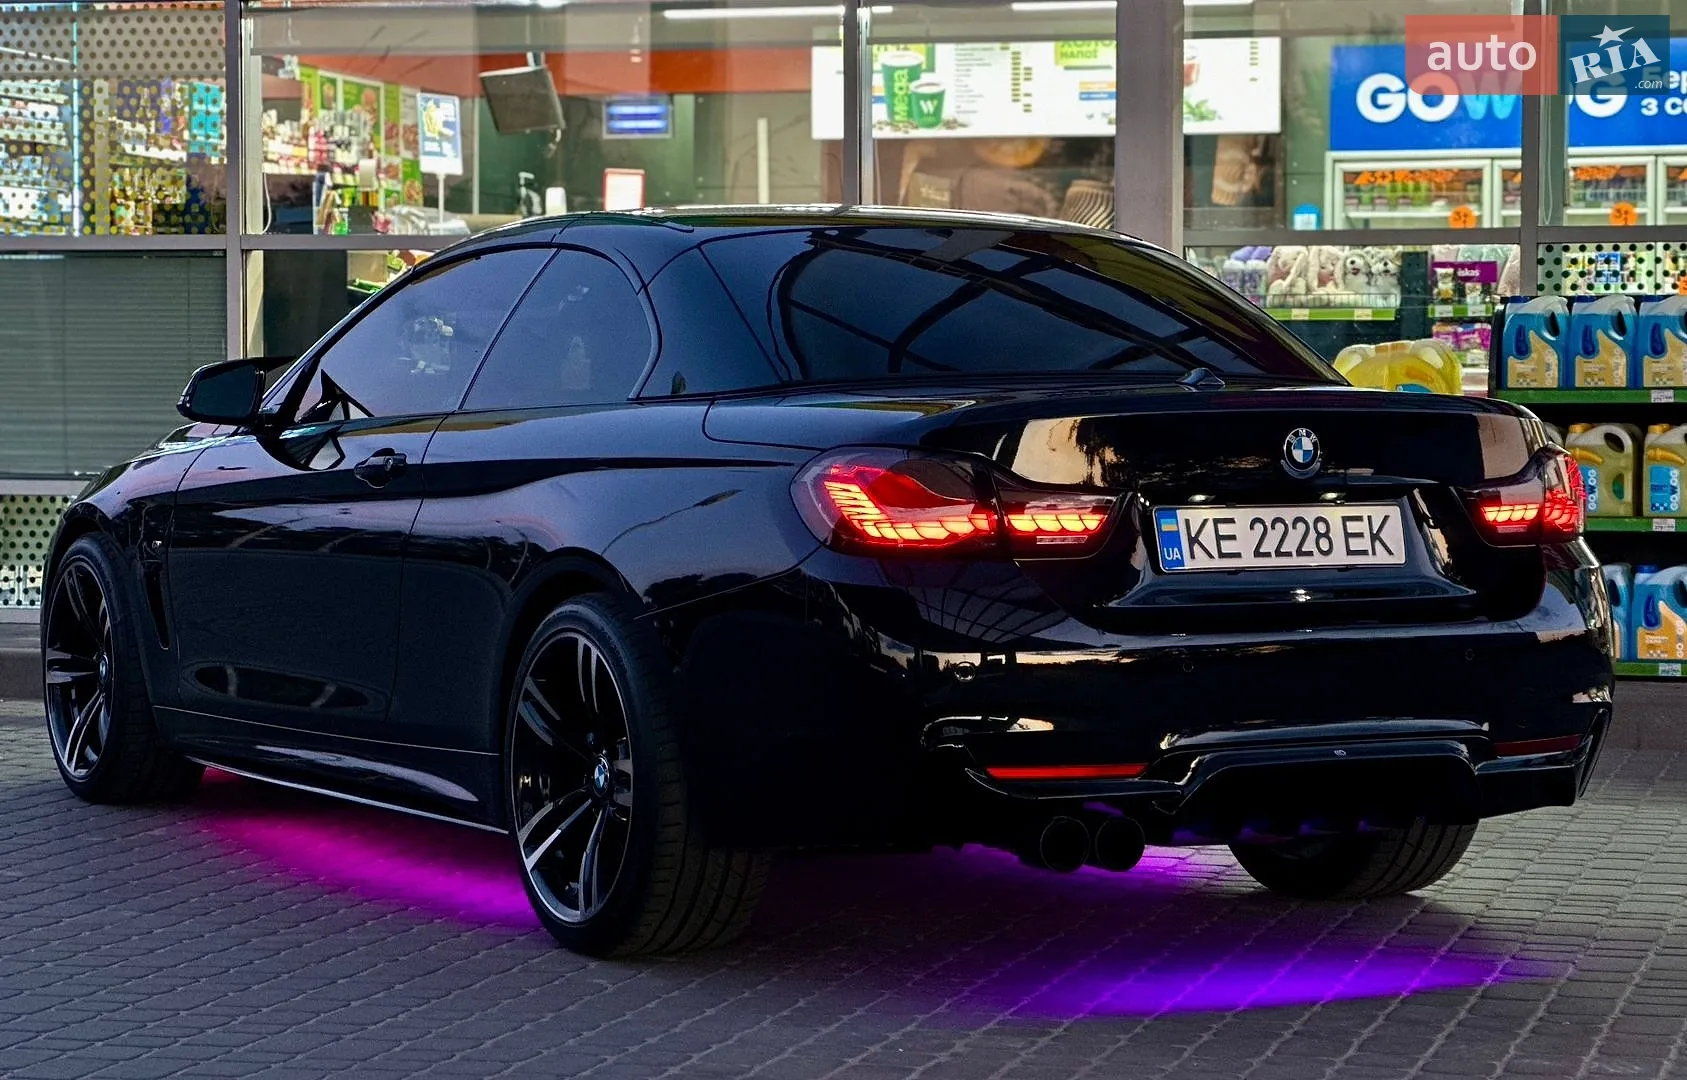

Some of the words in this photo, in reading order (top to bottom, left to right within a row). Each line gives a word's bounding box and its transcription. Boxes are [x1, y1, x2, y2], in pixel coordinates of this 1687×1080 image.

[1588, 469, 1597, 510] GOWOG
[1670, 470, 1679, 511] GOWOG
[1163, 547, 1182, 561] UA
[1184, 517, 1242, 560] KE
[1249, 515, 1334, 558] 2228
[1340, 514, 1395, 556] EK
